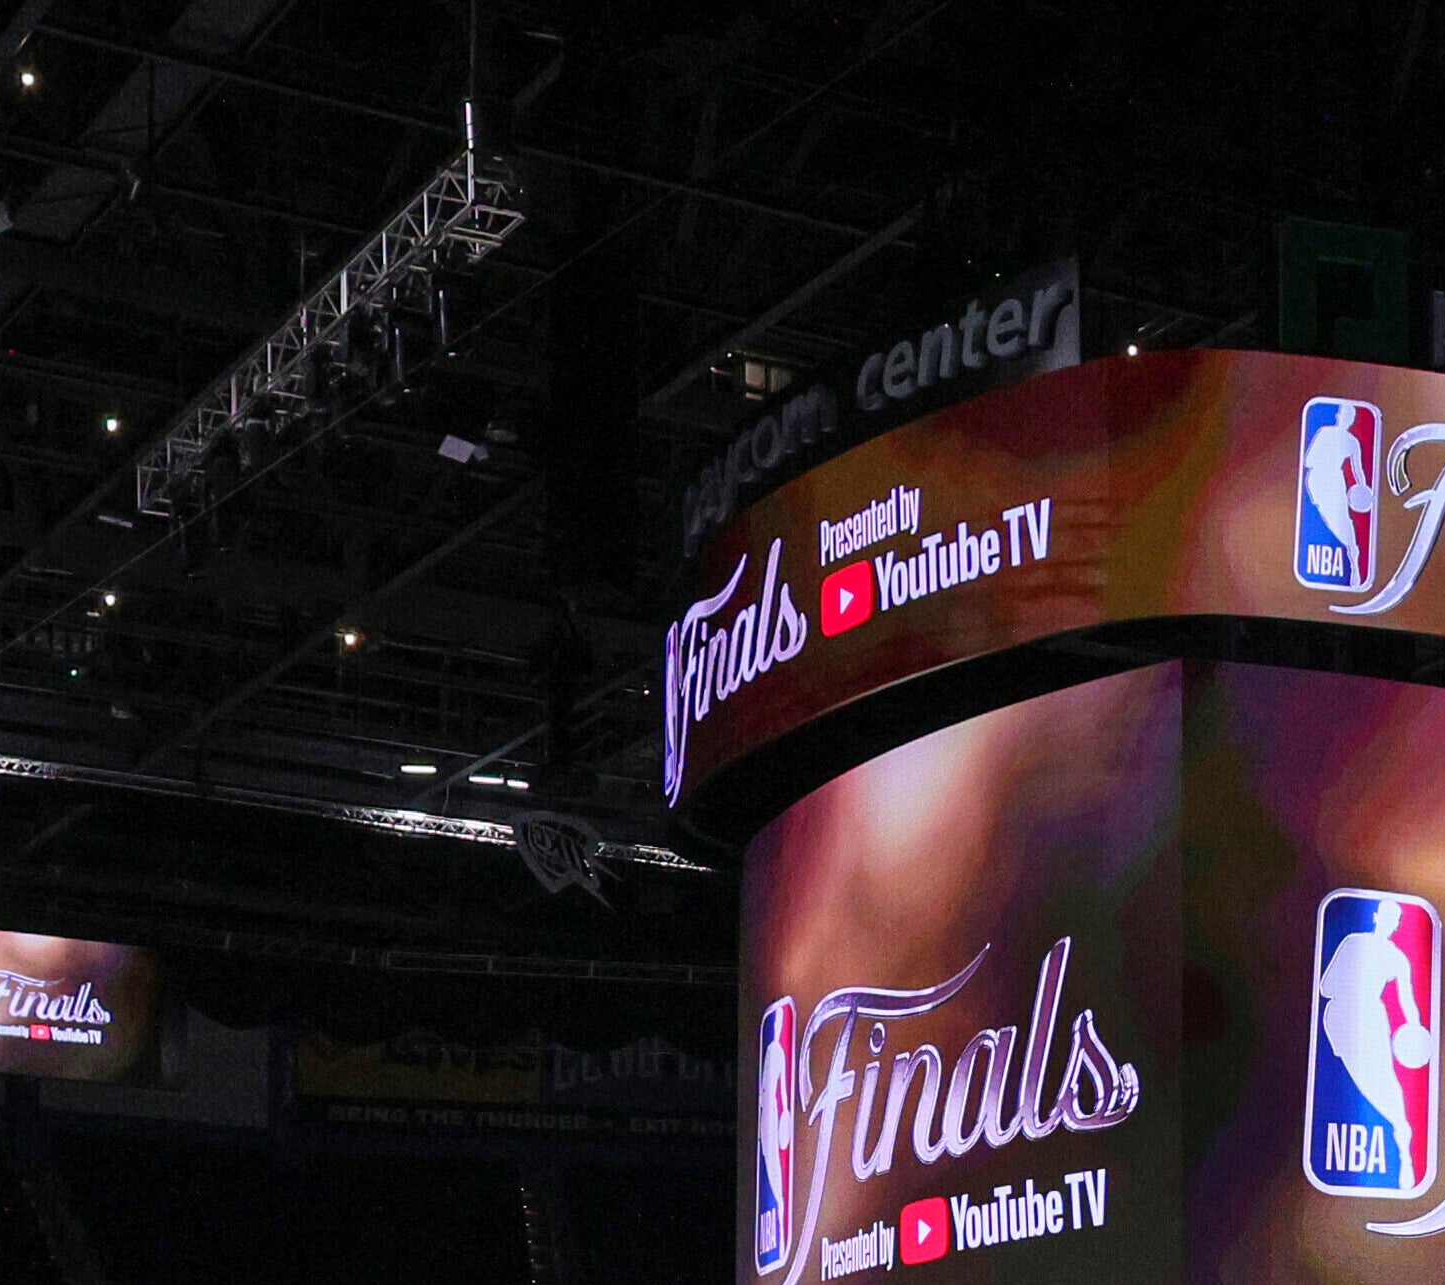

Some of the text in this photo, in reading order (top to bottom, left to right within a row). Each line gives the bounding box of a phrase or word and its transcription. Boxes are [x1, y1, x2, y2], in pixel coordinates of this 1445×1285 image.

[857, 284, 1071, 411] center
[820, 484, 921, 566] Presented by
[874, 498, 1051, 611] YouTube TV
[1307, 543, 1344, 578] NBA
[668, 538, 809, 808] Finals
[1325, 1121, 1388, 1176] NBA
[758, 1207, 777, 1255] NBA
[821, 1219, 895, 1282] Presented by
[949, 1168, 1107, 1252] YouTube TV
